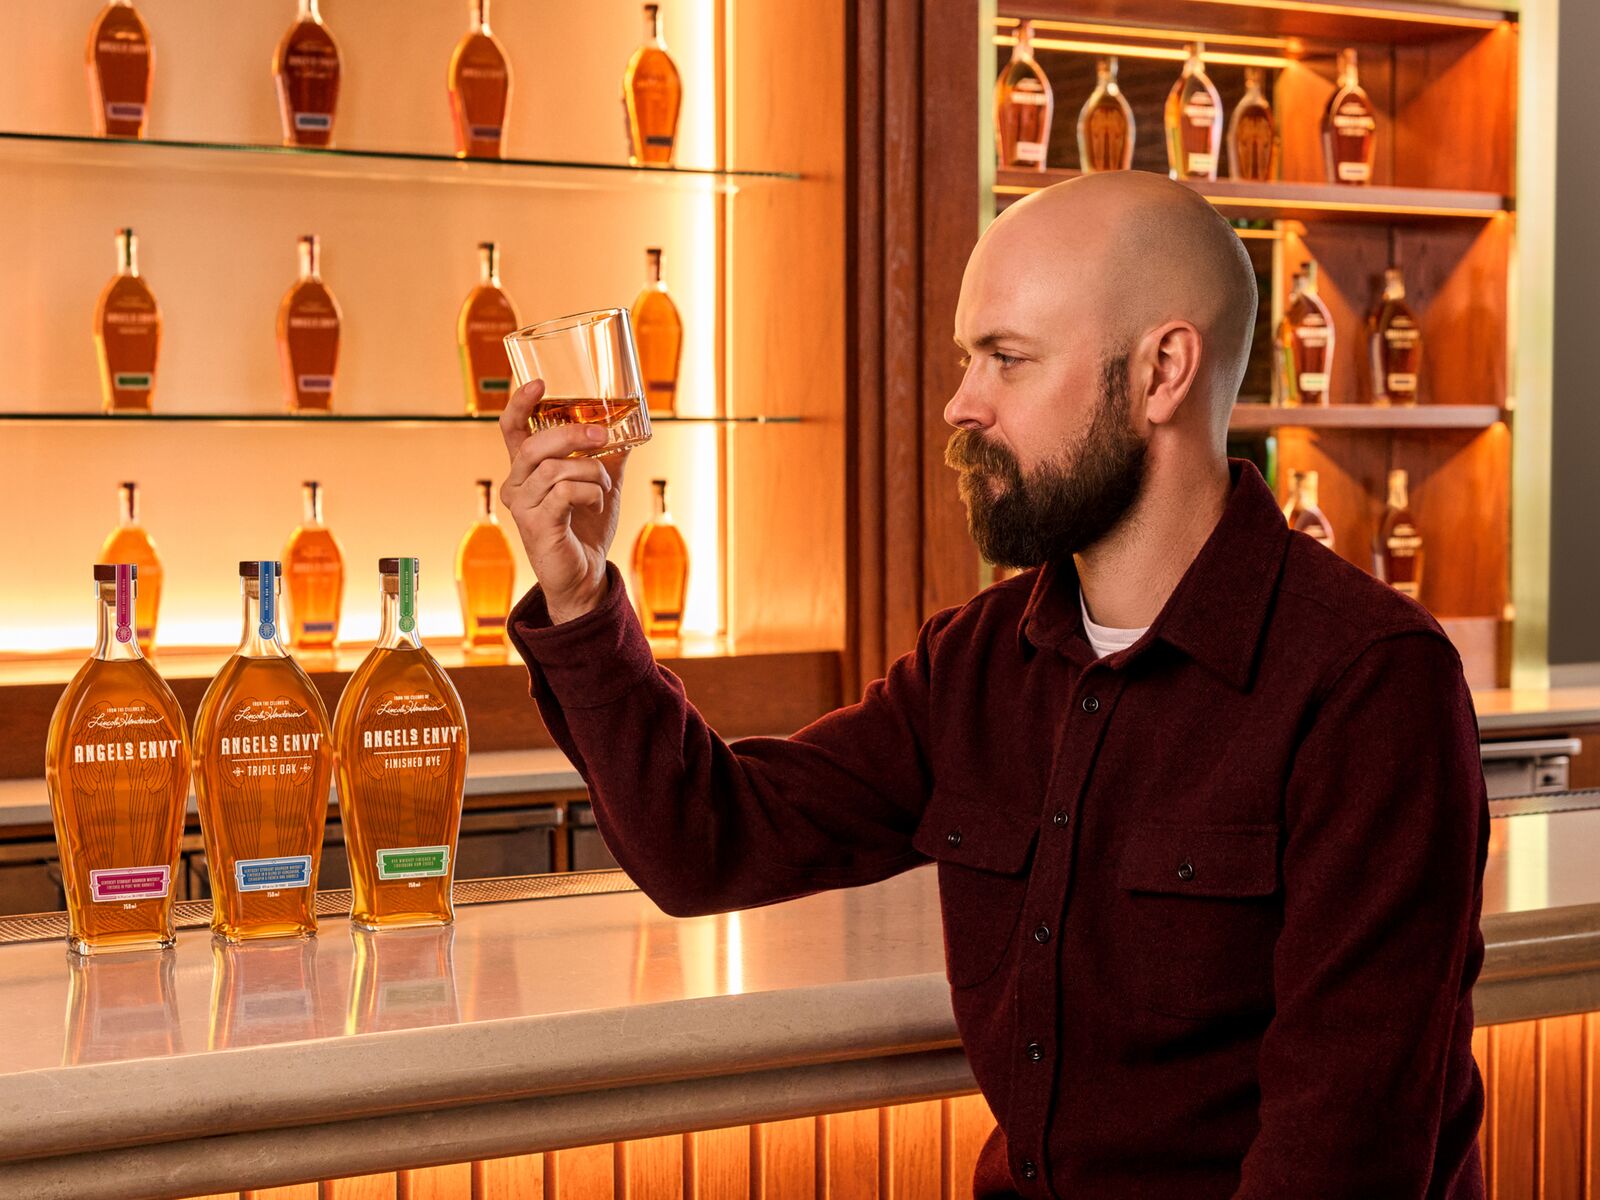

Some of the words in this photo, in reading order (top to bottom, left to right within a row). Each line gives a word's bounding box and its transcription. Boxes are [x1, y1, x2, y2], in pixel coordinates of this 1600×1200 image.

[221, 734, 278, 755] ANGELS
[284, 732, 320, 752] ENVY
[364, 728, 418, 748] ANGELS
[423, 726, 459, 745] ENVY
[74, 742, 134, 763] ANGELS
[140, 740, 178, 760] ENVY
[384, 757, 422, 769] FINISHED
[426, 756, 440, 766] RYE
[247, 764, 276, 776] TRIPLE
[280, 763, 297, 775] OAK
